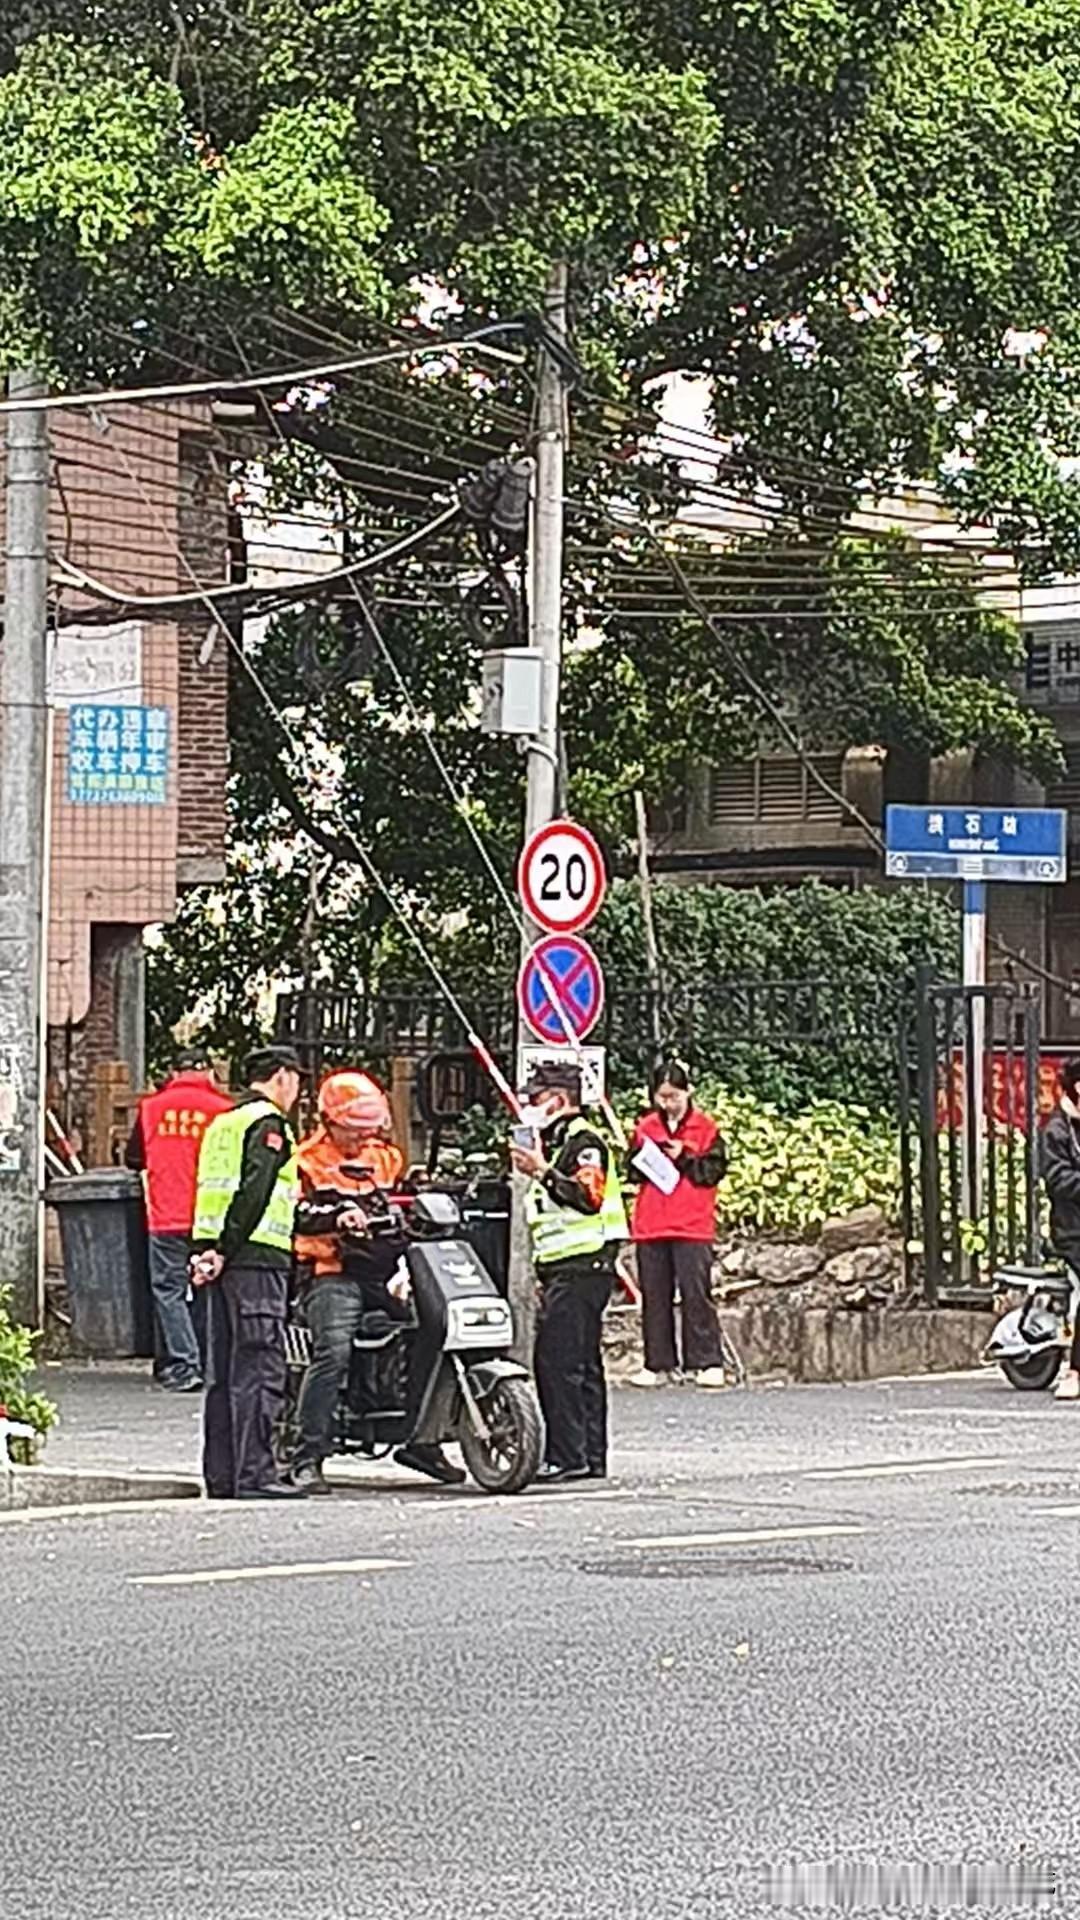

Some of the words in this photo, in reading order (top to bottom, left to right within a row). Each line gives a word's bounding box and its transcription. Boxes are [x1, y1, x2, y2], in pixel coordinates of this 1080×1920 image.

[71, 708, 167, 729] 代办违章
[541, 853, 586, 900] 20
